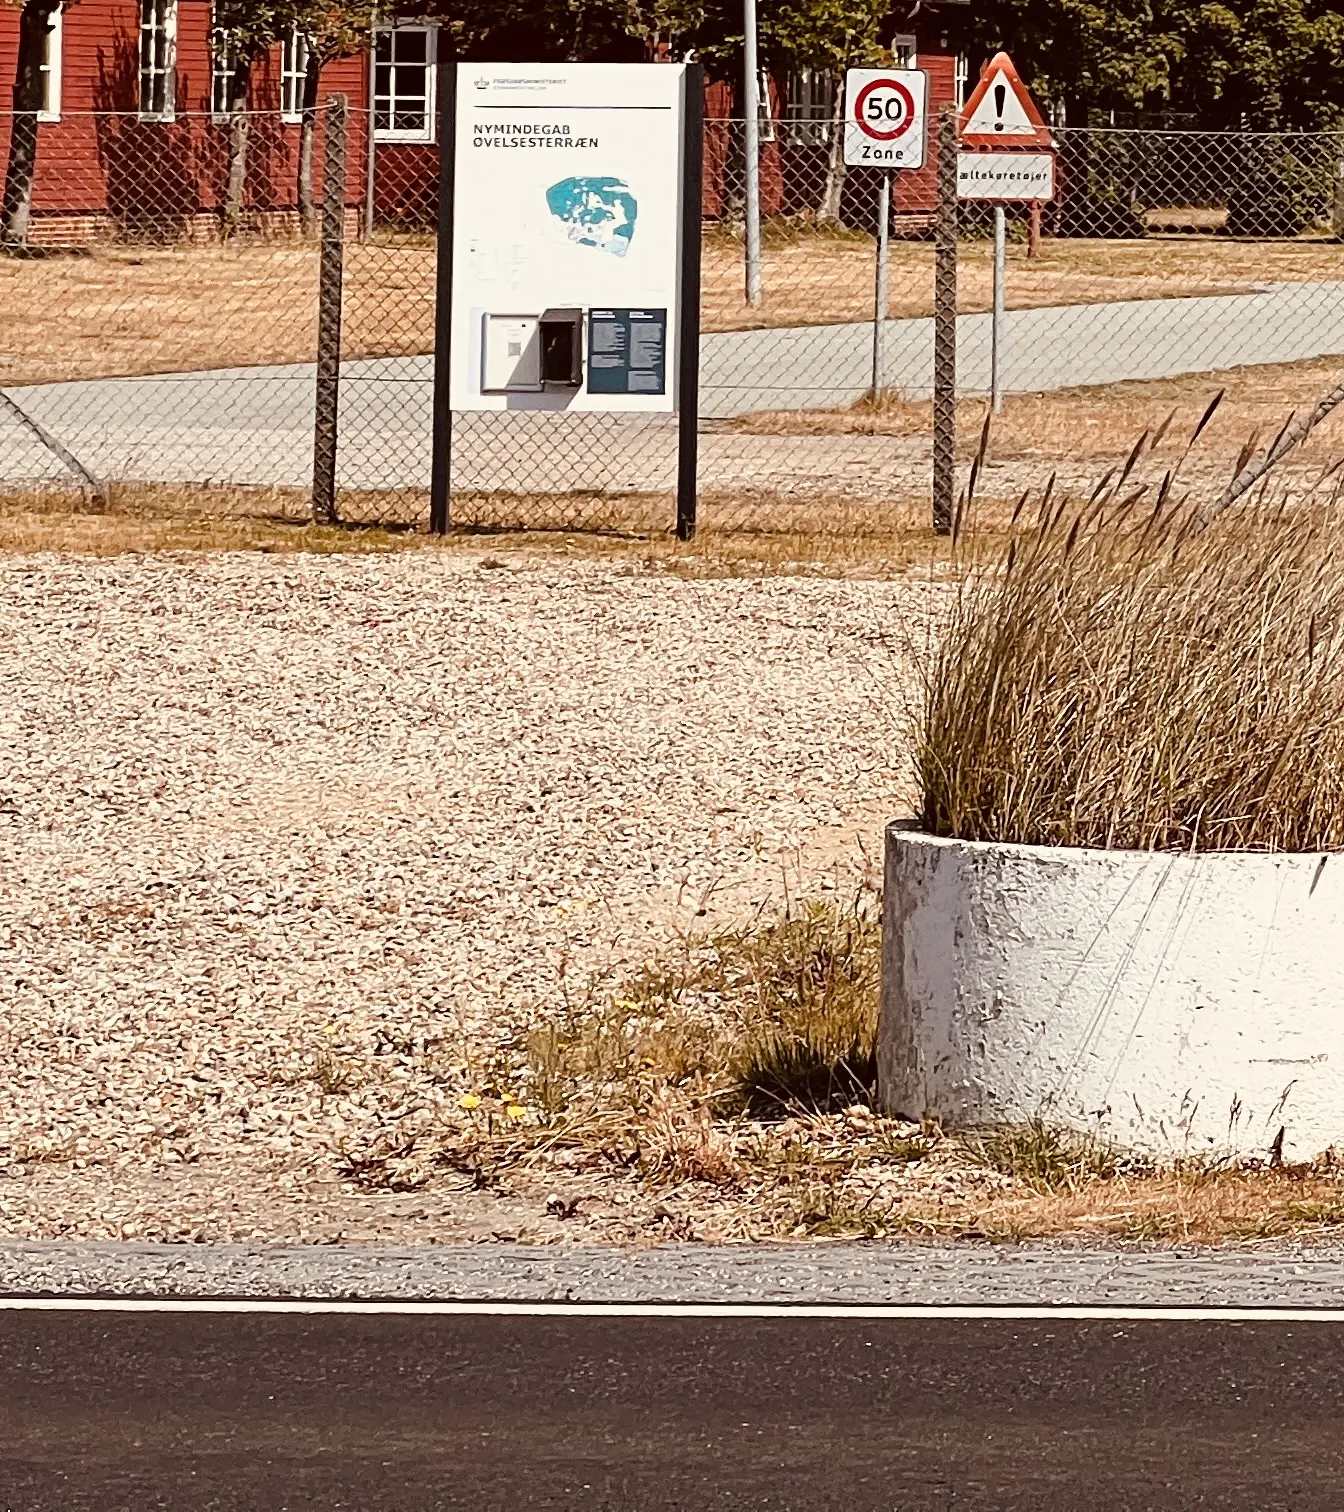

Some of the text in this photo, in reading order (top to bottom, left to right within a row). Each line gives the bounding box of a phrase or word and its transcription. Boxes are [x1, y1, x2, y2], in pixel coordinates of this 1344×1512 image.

[868, 98, 902, 120] 50
[474, 124, 570, 135] NYMINDEGAB
[473, 137, 598, 148] ØVELSESTERRÆN
[862, 146, 904, 160] Zone
[958, 170, 1048, 182] æltekøretøjer
